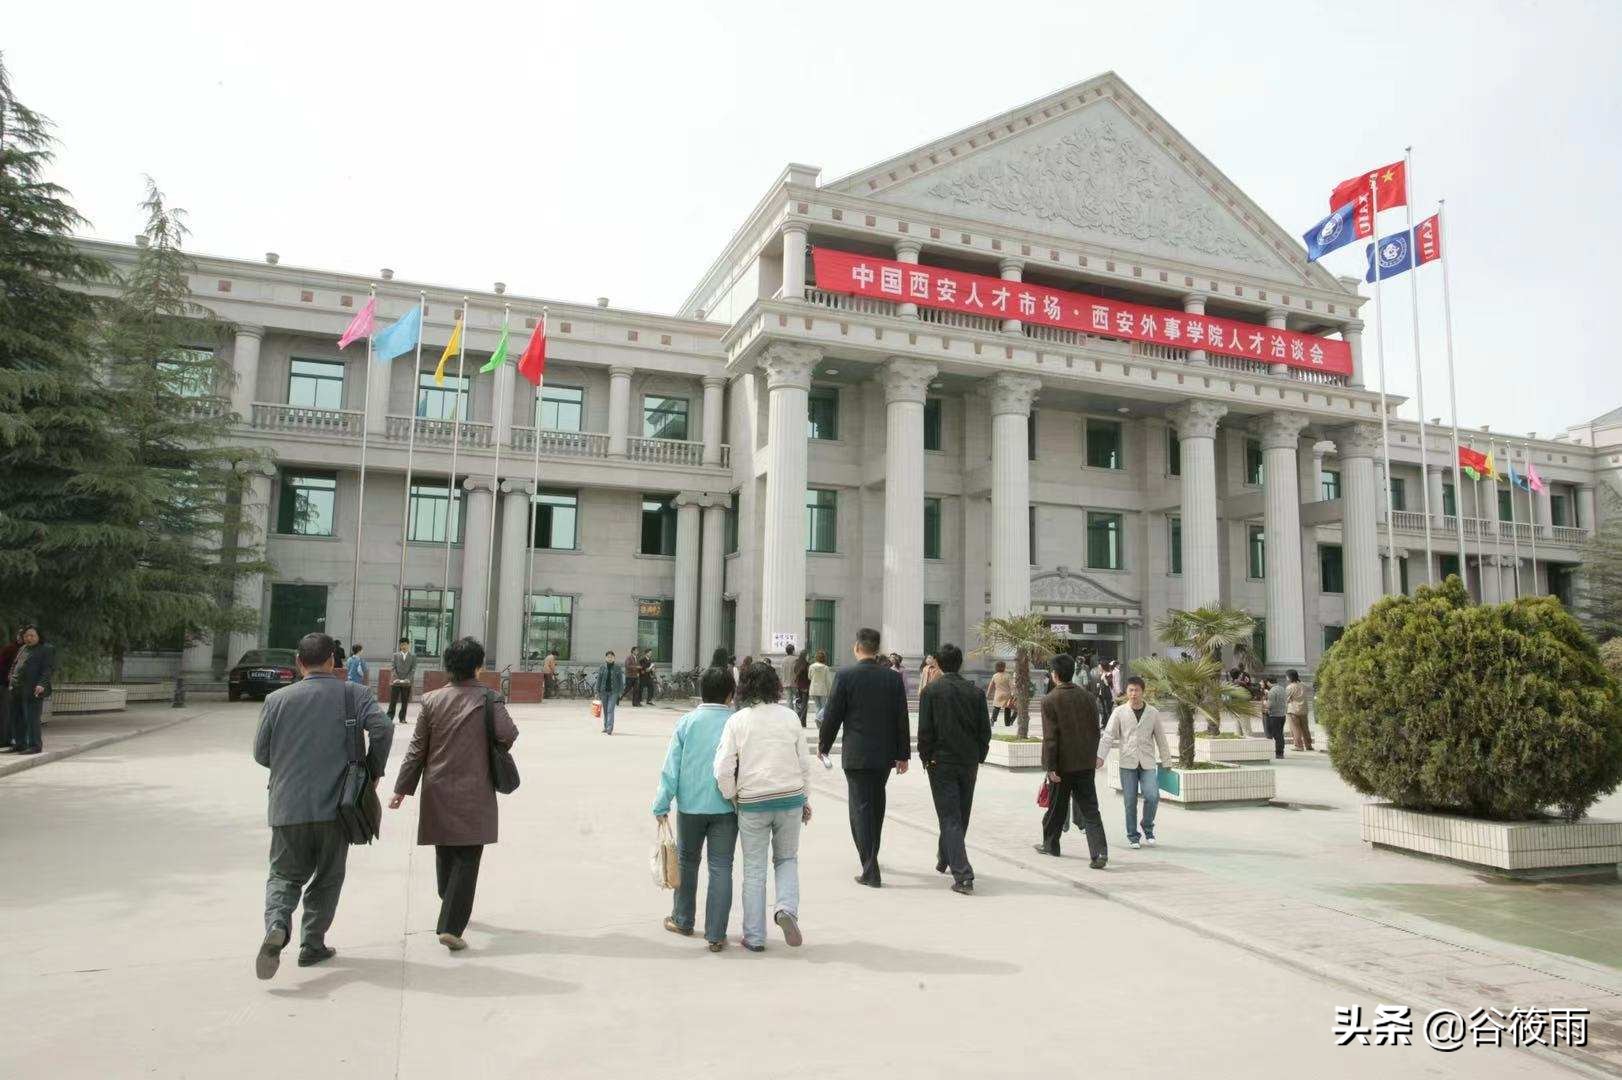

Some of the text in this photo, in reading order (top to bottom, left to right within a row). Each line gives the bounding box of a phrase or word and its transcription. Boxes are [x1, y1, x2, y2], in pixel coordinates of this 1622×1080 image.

[851, 263, 1325, 365] 中国西安人才市场·西安外事学院人才洽谈会
